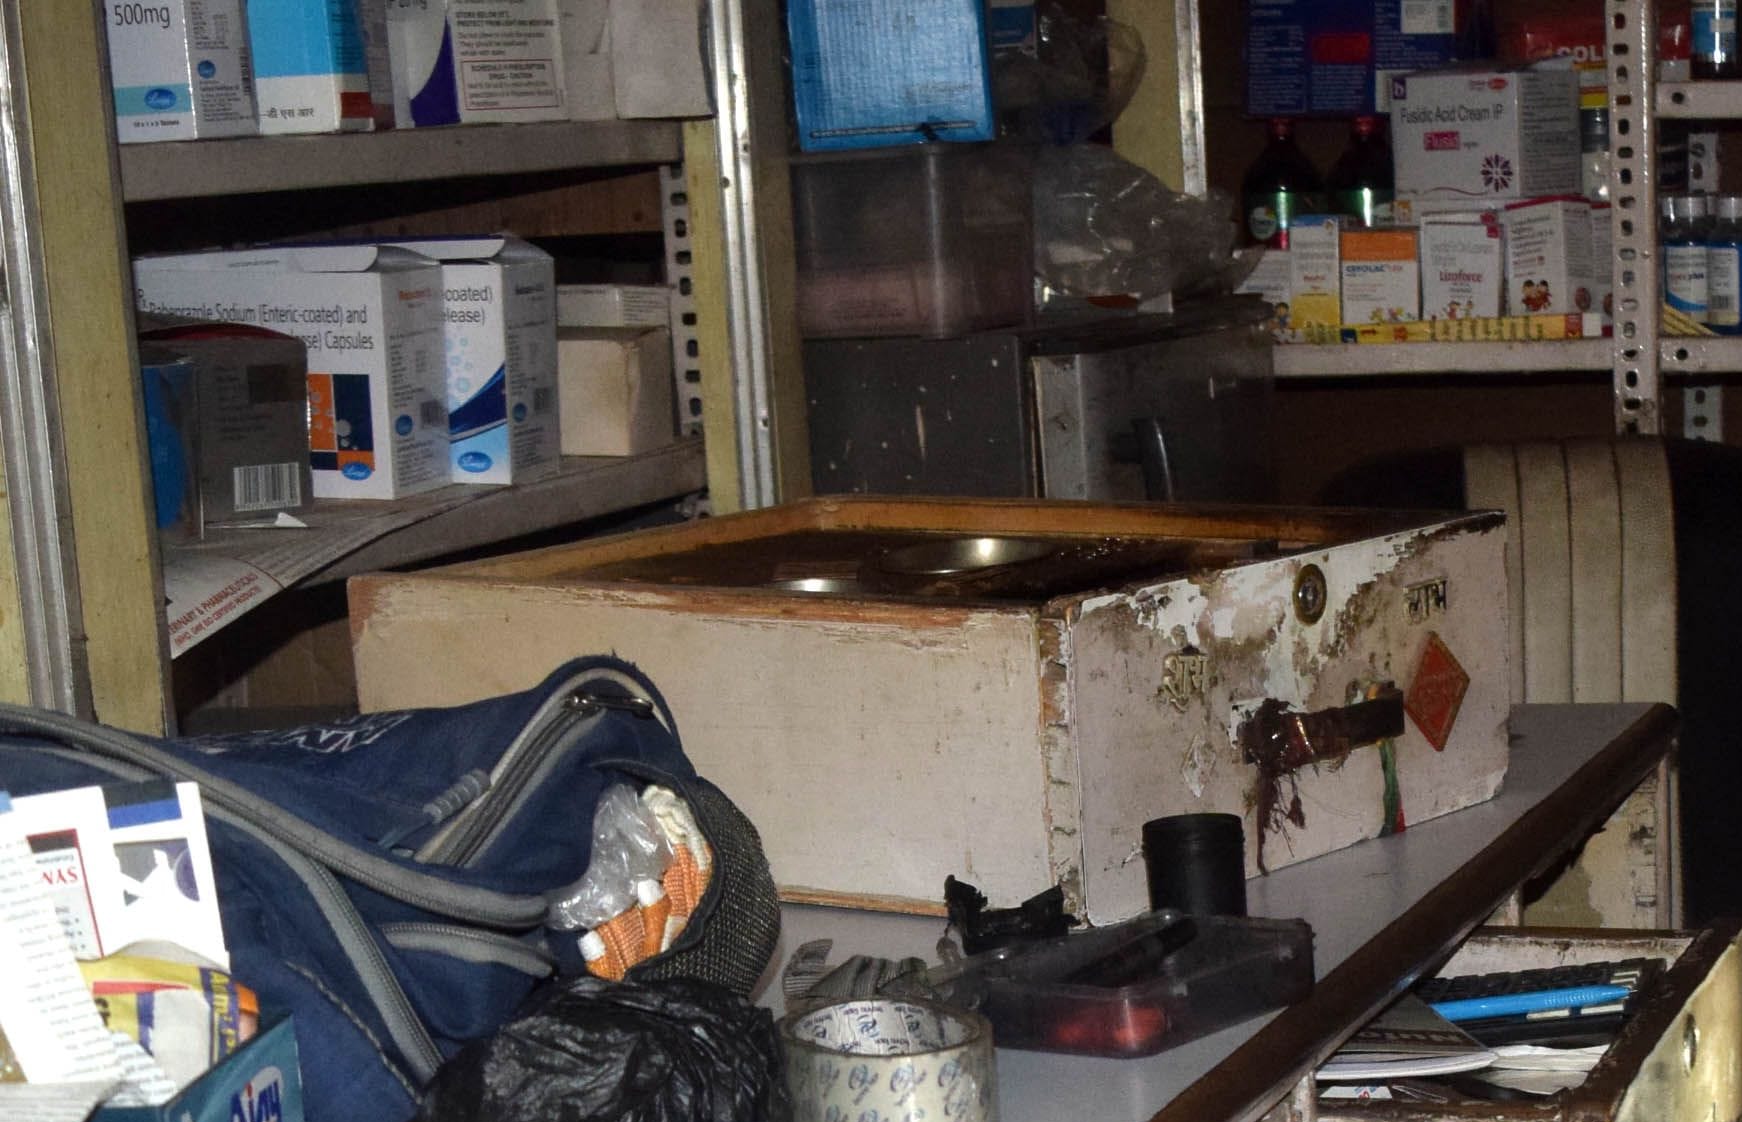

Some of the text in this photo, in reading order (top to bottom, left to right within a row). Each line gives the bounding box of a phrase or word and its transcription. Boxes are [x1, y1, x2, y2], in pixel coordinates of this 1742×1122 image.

[114, 3, 171, 29] 500mg
[216, 302, 255, 323] Sodium
[345, 304, 368, 324] and
[324, 330, 375, 355] Capsules
